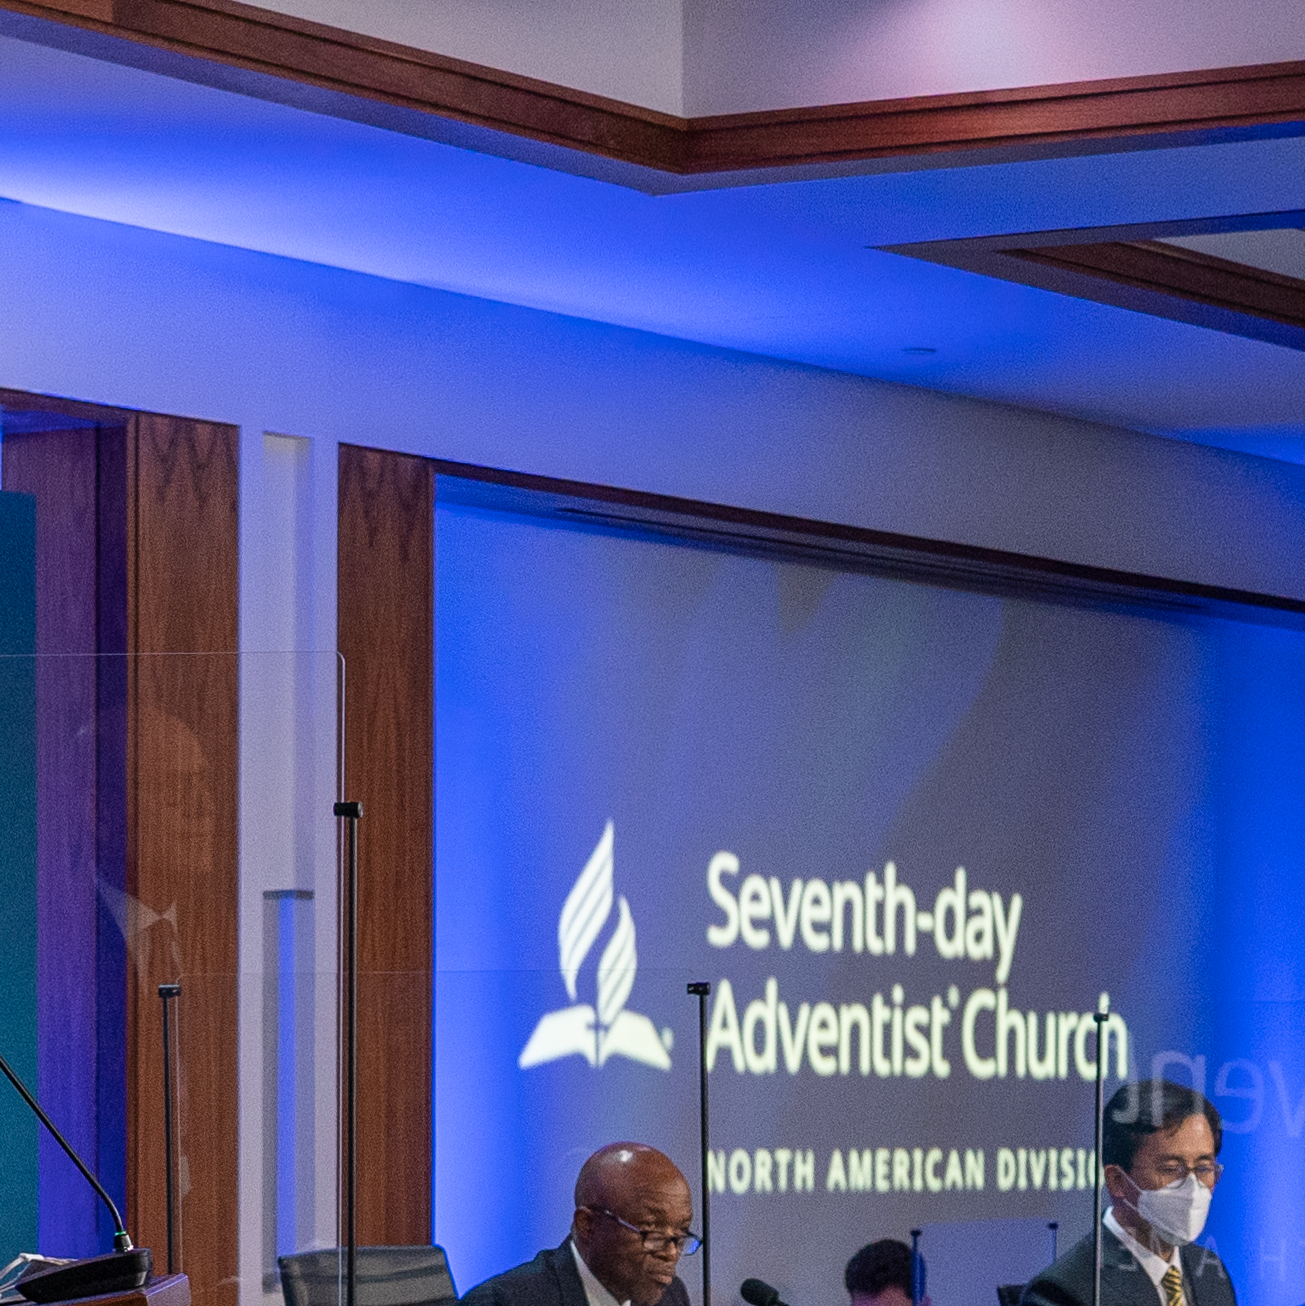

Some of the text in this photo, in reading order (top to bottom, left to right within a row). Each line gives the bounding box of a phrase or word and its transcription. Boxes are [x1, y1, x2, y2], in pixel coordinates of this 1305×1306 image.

[706, 850, 1023, 984] Seventh-day
[706, 976, 1129, 1081] Adventist Church
[707, 1147, 1106, 1194] NORTH AMERICAN DIVISI
